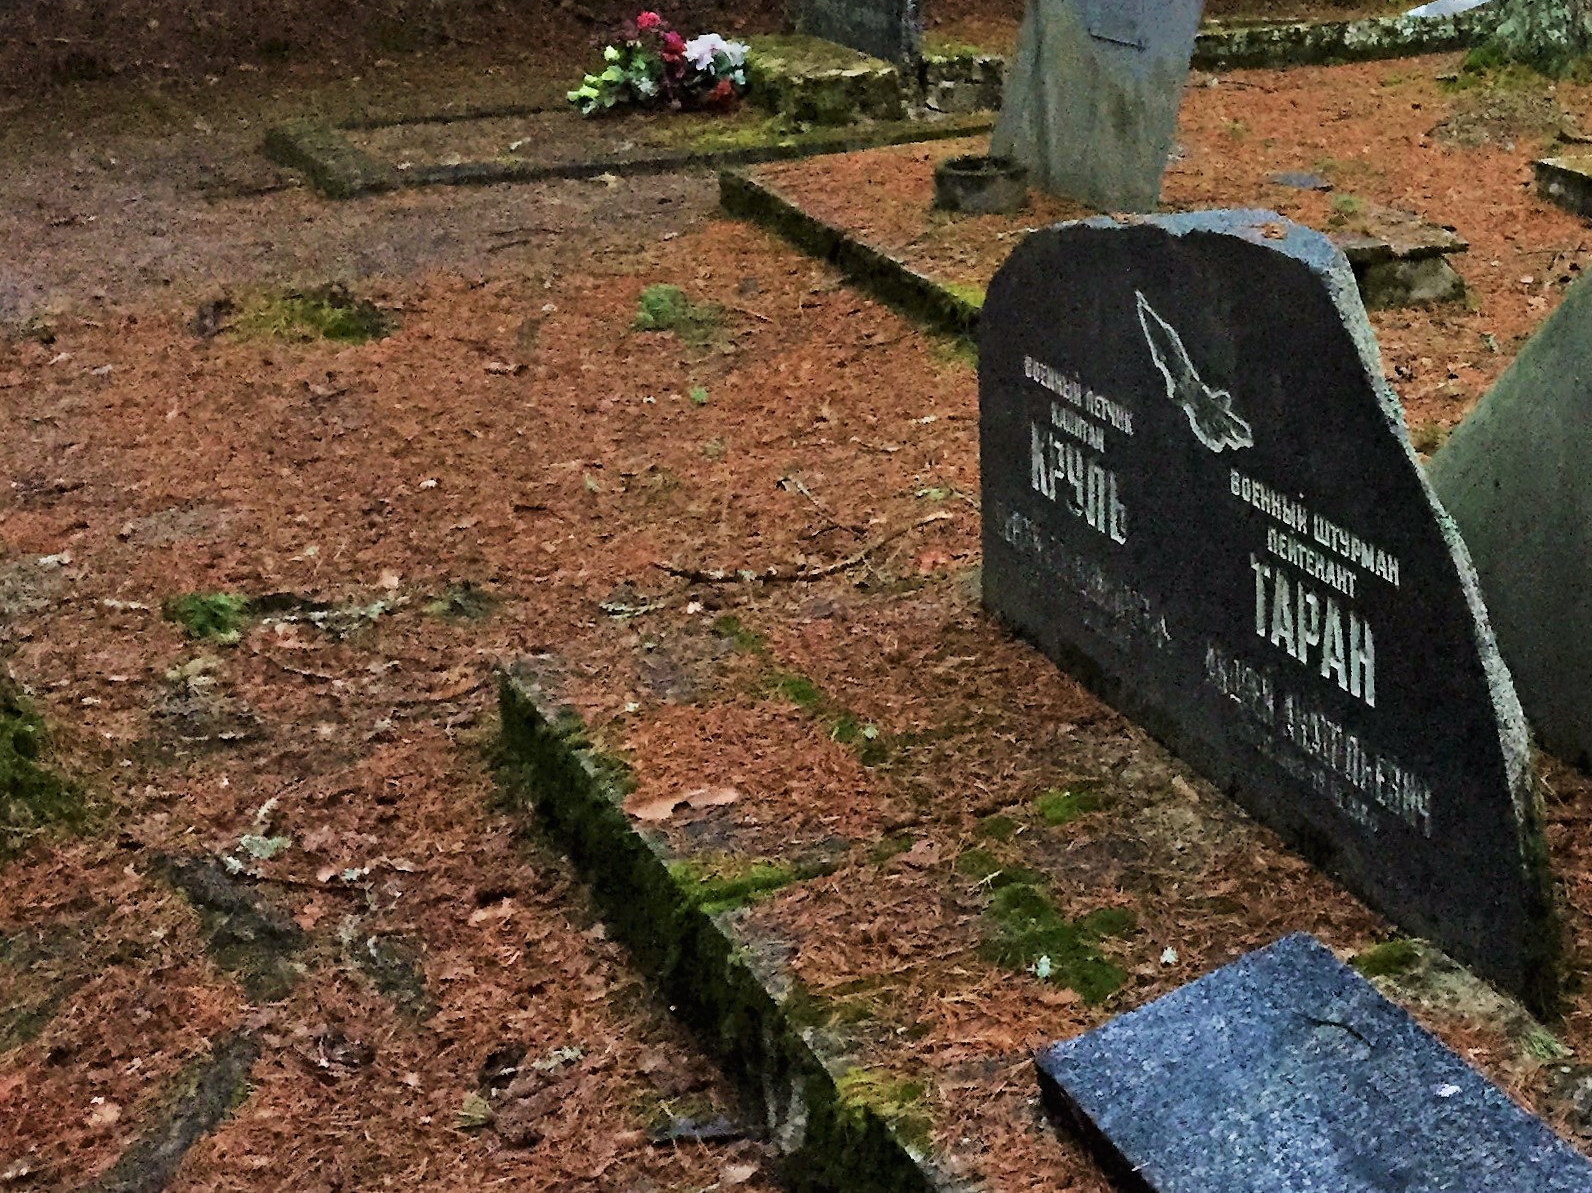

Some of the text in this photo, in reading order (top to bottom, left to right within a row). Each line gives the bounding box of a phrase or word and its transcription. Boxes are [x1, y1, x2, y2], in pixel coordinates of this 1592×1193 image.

[1031, 420, 1128, 545] КРУЛЬ
[1230, 468, 1400, 587] ВОЕННЫЙ ШТУРМАН
[1267, 526, 1357, 598] ЛЕЙТЕНАНТ
[1250, 552, 1375, 708] ТАРАН
